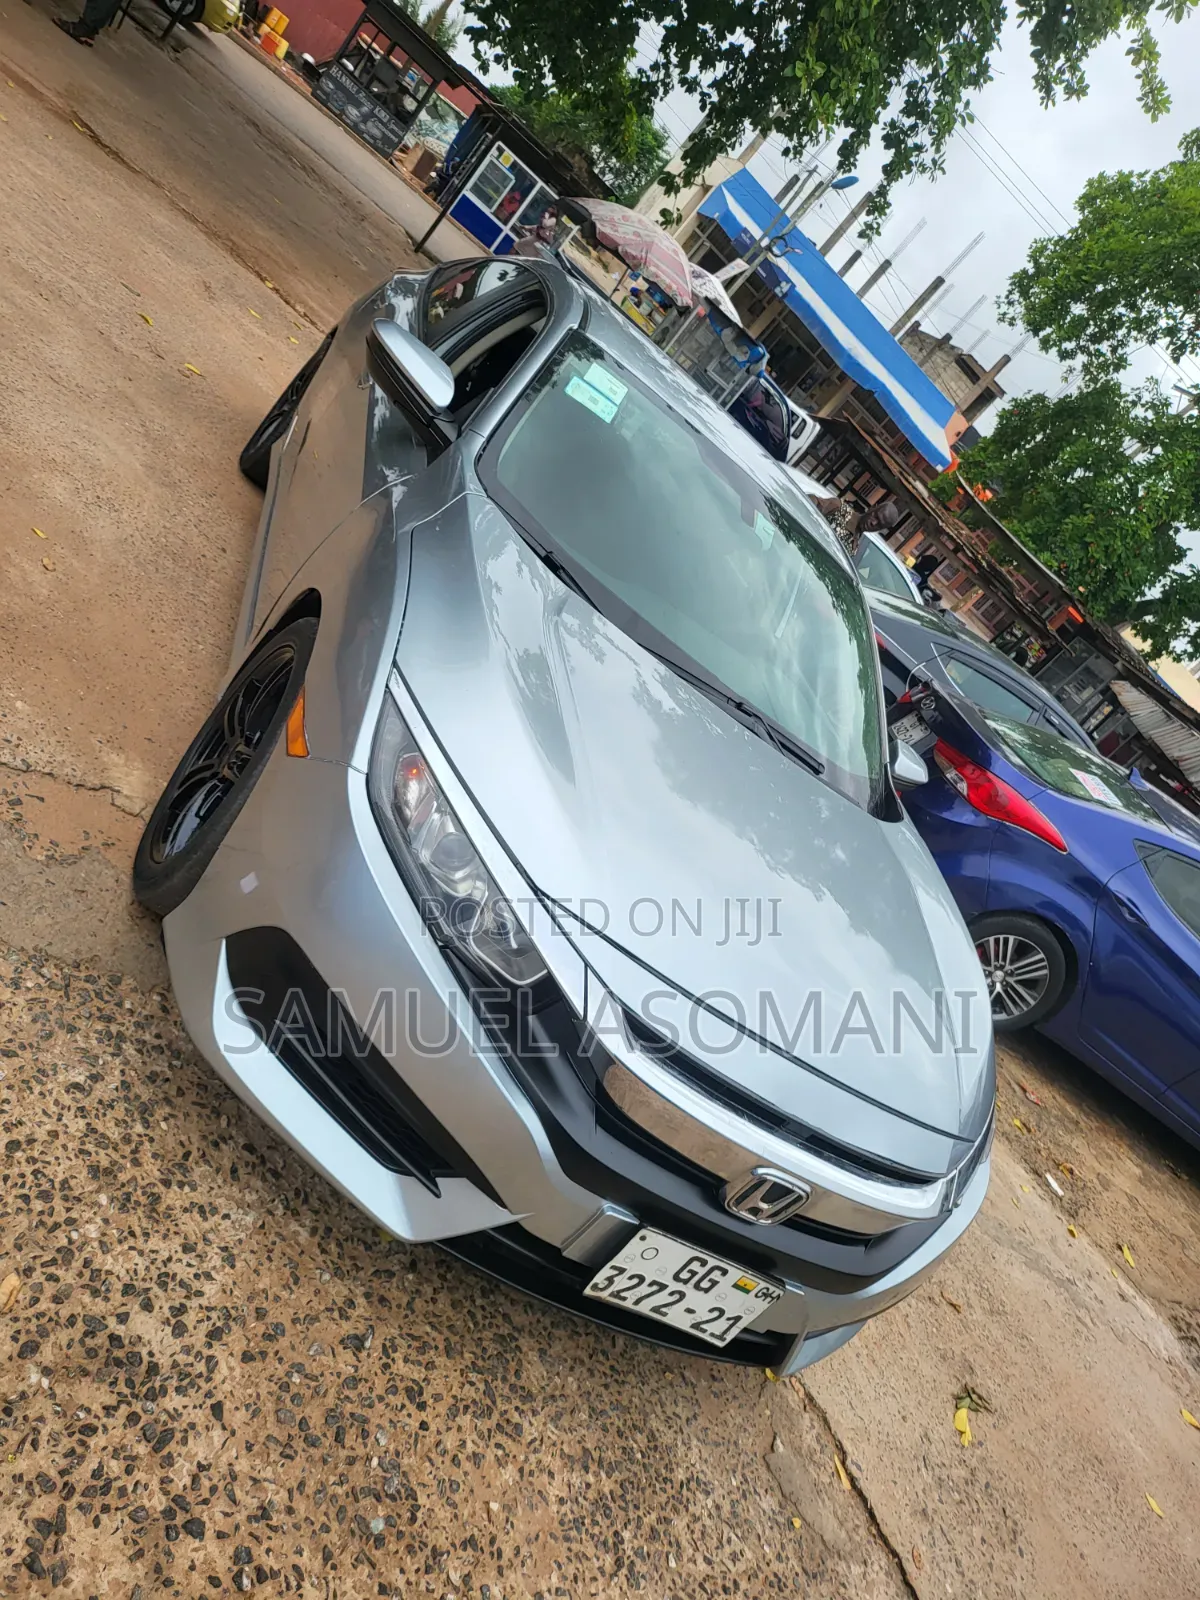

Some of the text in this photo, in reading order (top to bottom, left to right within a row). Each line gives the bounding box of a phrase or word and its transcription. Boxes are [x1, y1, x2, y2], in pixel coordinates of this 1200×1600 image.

[329, 64, 359, 95] HANNAH
[672, 1255, 729, 1294] GG
[589, 1264, 744, 1342] 3272-21
